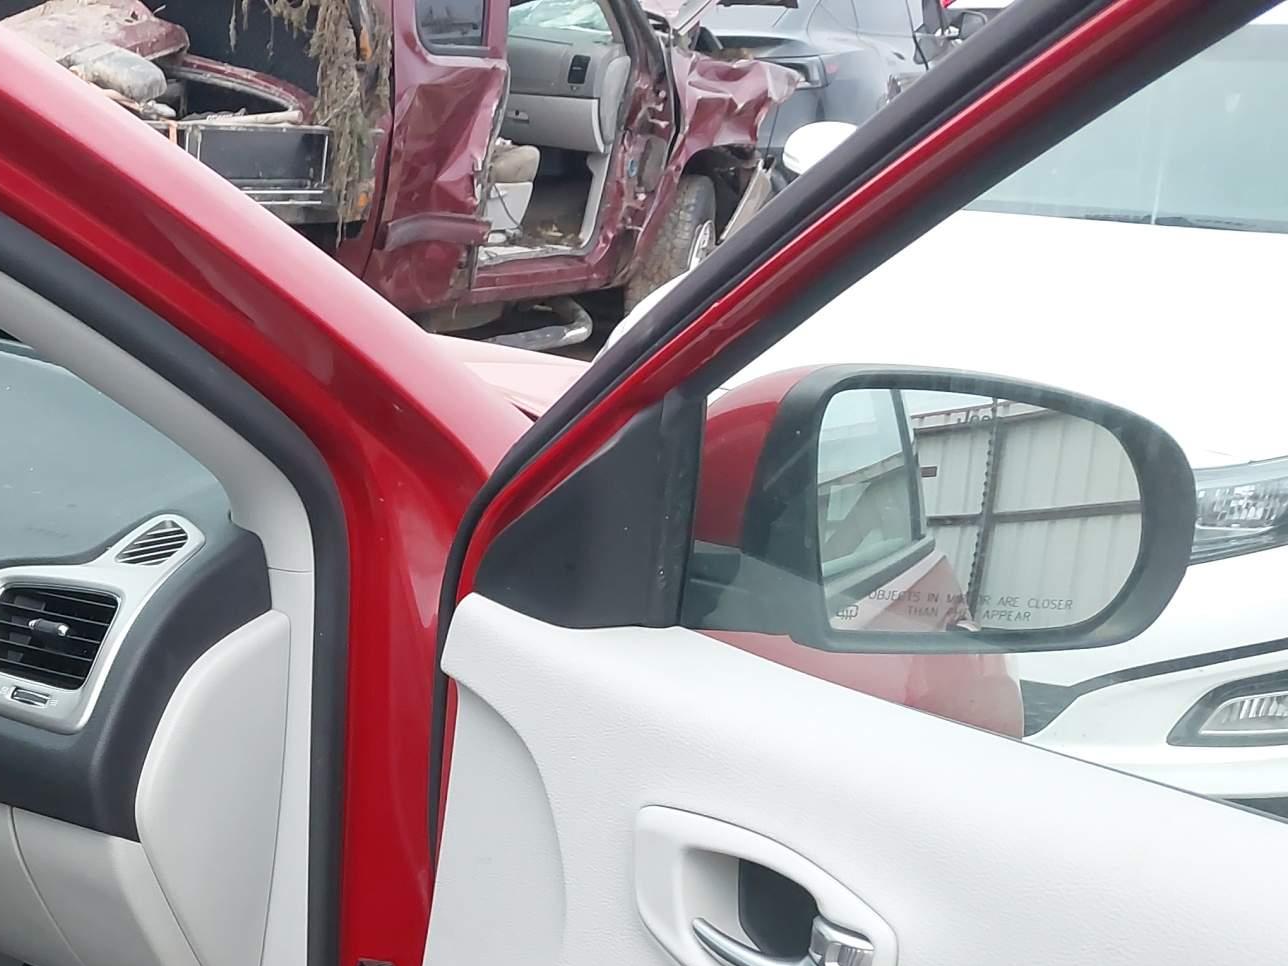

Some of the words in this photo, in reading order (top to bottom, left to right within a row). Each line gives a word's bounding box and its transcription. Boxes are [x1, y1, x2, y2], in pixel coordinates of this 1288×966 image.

[868, 590, 921, 602] OBJECTS
[927, 592, 940, 603] IN
[997, 595, 1021, 608] ARE
[1026, 597, 1073, 610] CLOSER
[907, 606, 939, 617] THAN
[982, 609, 1032, 622] APPEAR
